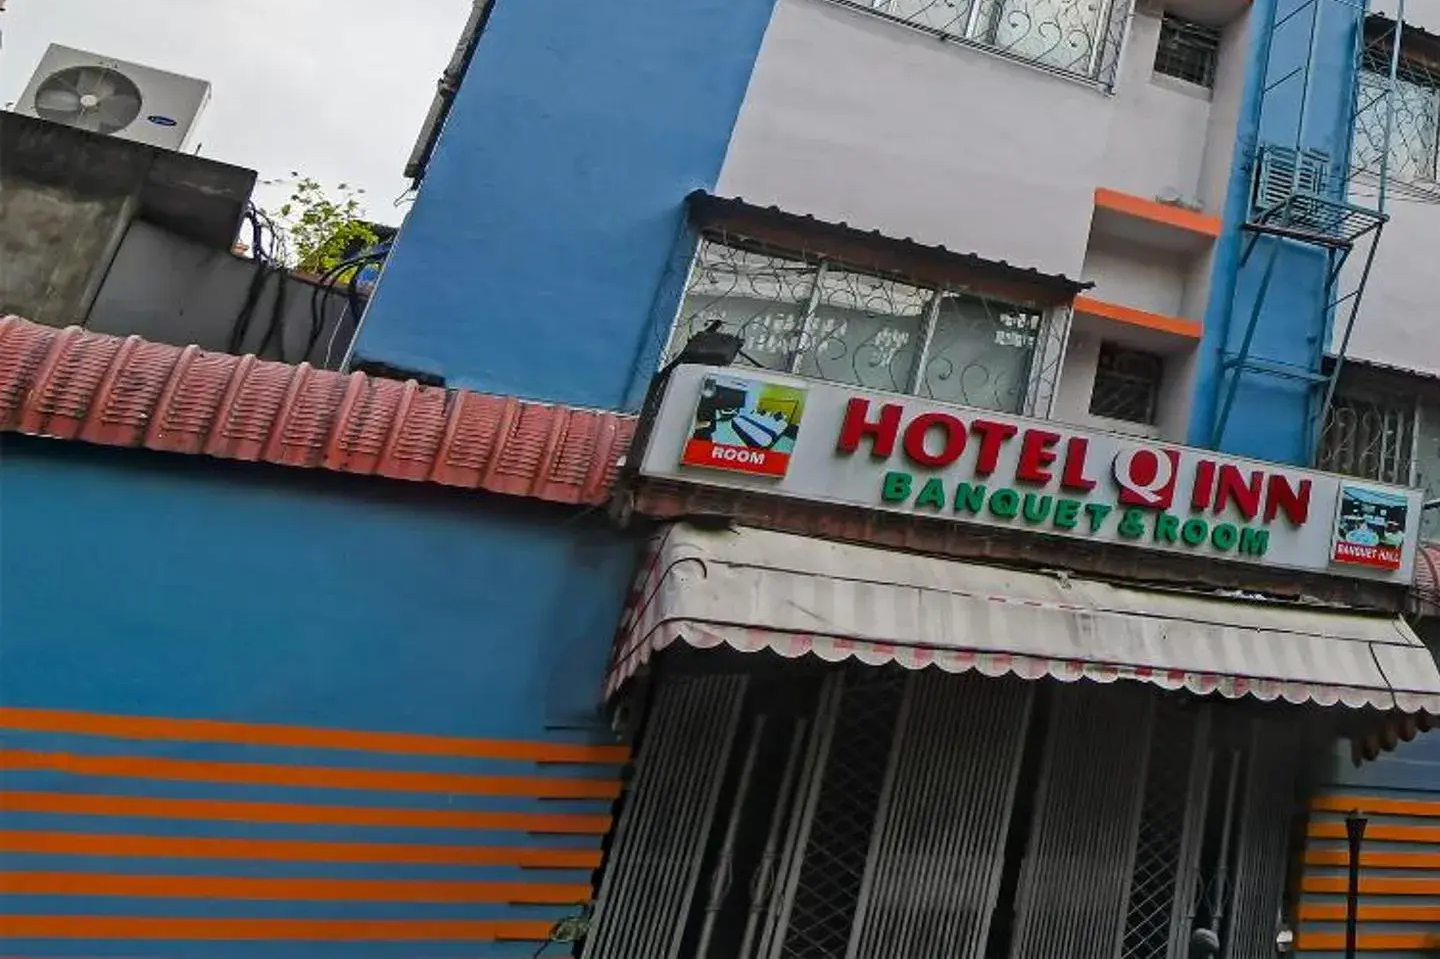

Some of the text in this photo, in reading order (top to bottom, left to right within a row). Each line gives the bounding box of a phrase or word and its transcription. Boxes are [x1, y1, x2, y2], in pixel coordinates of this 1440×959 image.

[711, 446, 765, 465] ROOM
[837, 397, 1313, 526] HOTEL Q INN
[880, 471, 1270, 556] BANQUET & ROOM
